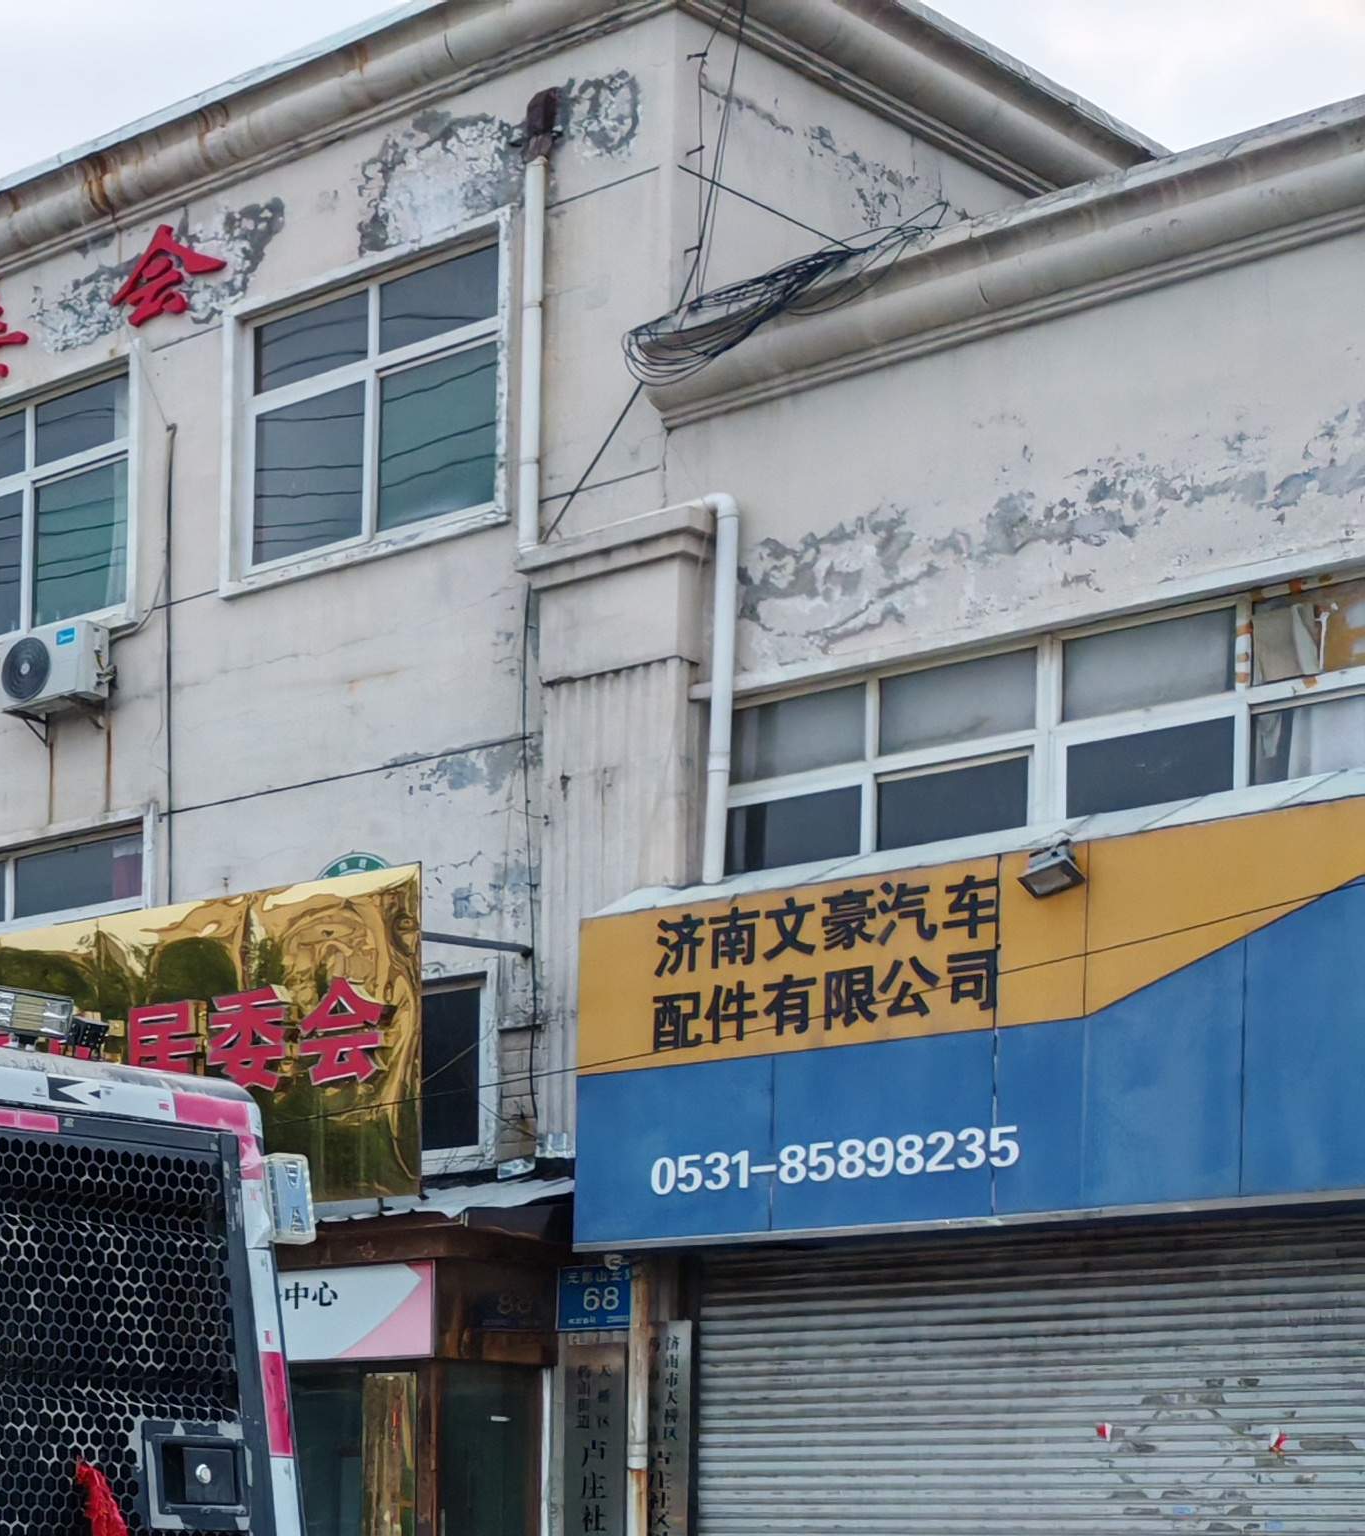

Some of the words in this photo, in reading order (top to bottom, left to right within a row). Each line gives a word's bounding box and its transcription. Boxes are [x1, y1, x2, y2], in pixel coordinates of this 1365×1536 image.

[653, 876, 996, 978] 济南文豪汽车
[652, 949, 996, 1051] 配件有限公司
[651, 1125, 1021, 1196] 0531-85898235
[279, 1281, 338, 1309] 中心
[583, 1286, 620, 1311] 68
